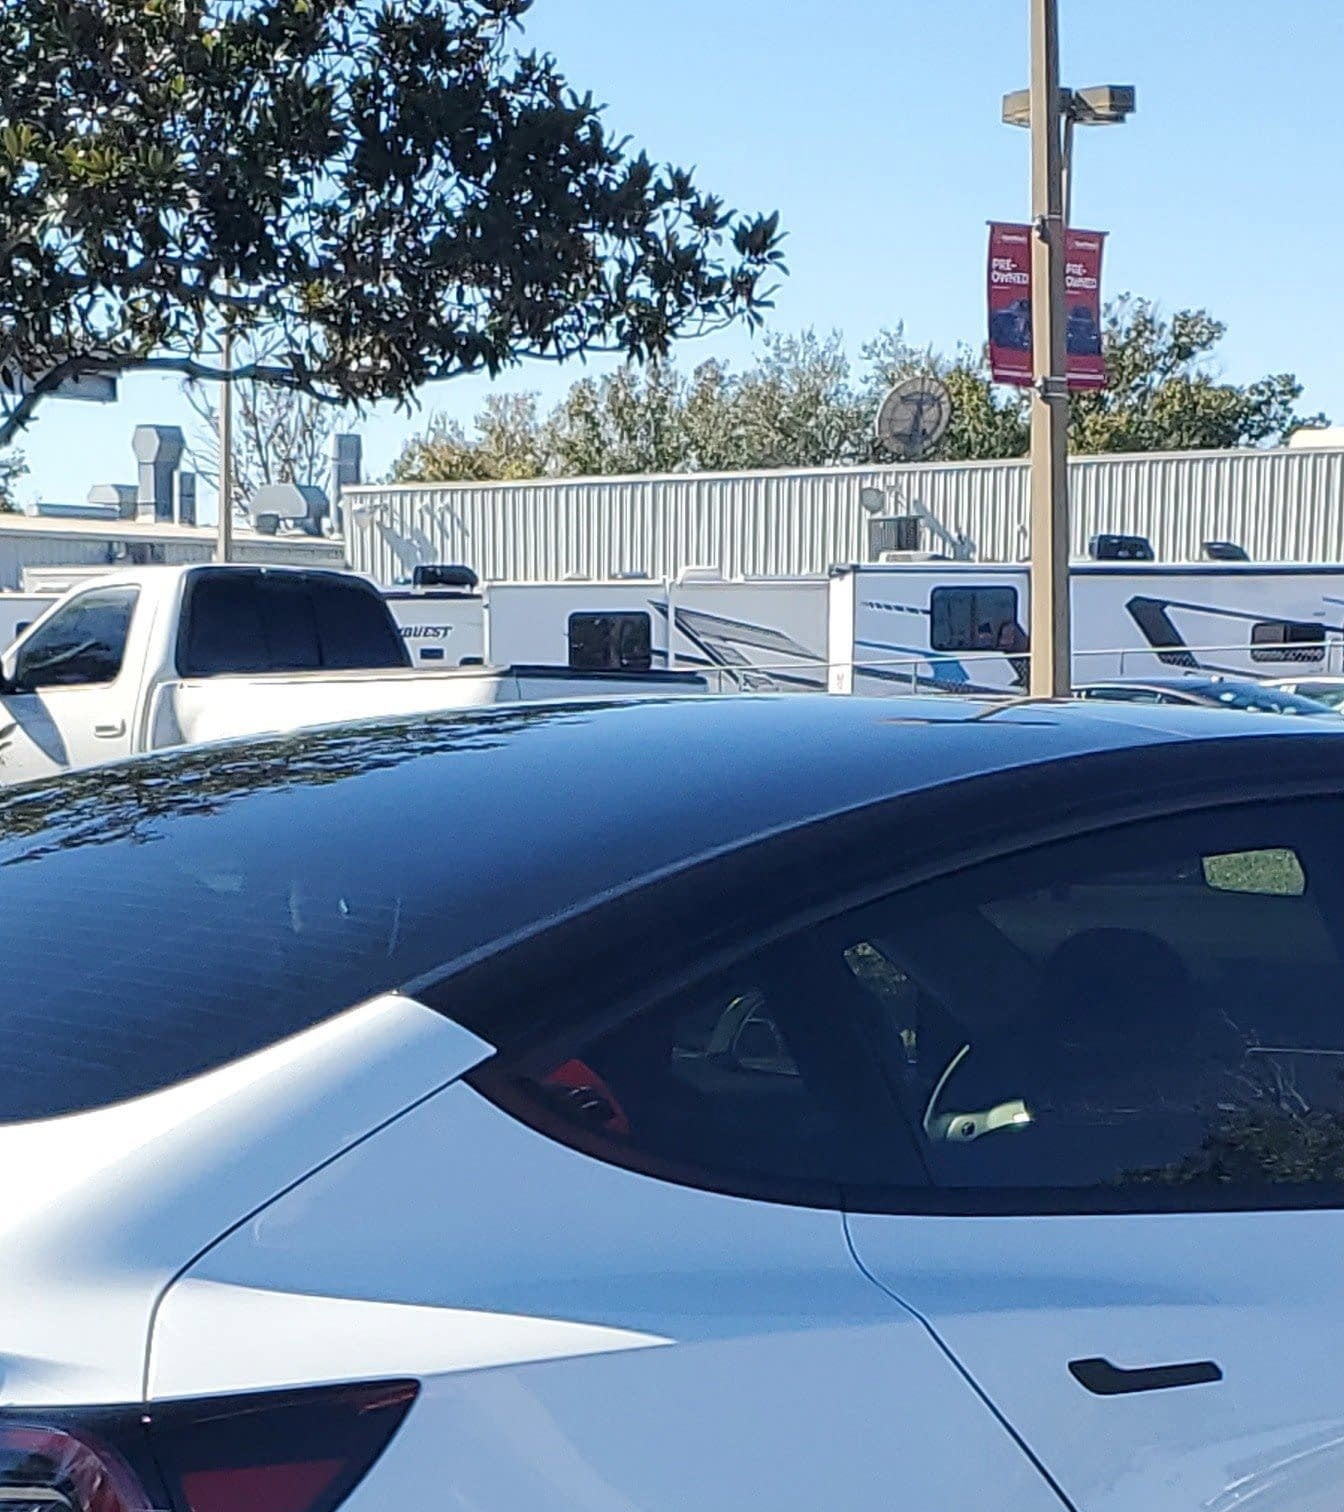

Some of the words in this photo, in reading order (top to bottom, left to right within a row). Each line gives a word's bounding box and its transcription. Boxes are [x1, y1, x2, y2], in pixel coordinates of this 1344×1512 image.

[992, 258, 1017, 271] PRE-
[991, 271, 1029, 285] OWNED
[1065, 276, 1097, 289] OWNED
